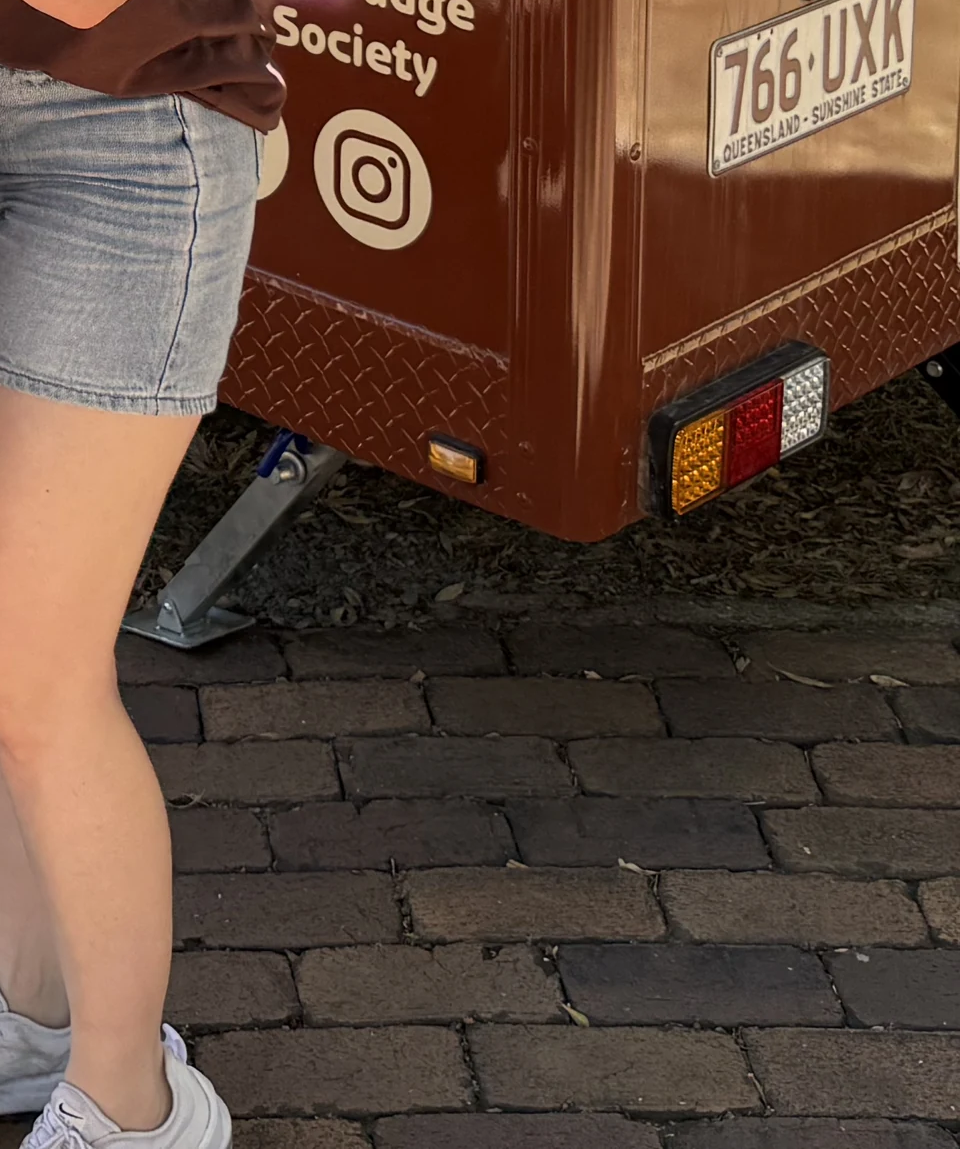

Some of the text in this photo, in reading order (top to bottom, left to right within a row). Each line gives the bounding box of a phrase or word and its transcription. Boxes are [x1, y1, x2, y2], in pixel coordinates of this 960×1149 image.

[273, 5, 438, 97] Society
[723, 114, 801, 164] QUEENSLAND
[812, 84, 867, 125] SUNSHINE
[871, 68, 903, 98] STATE
